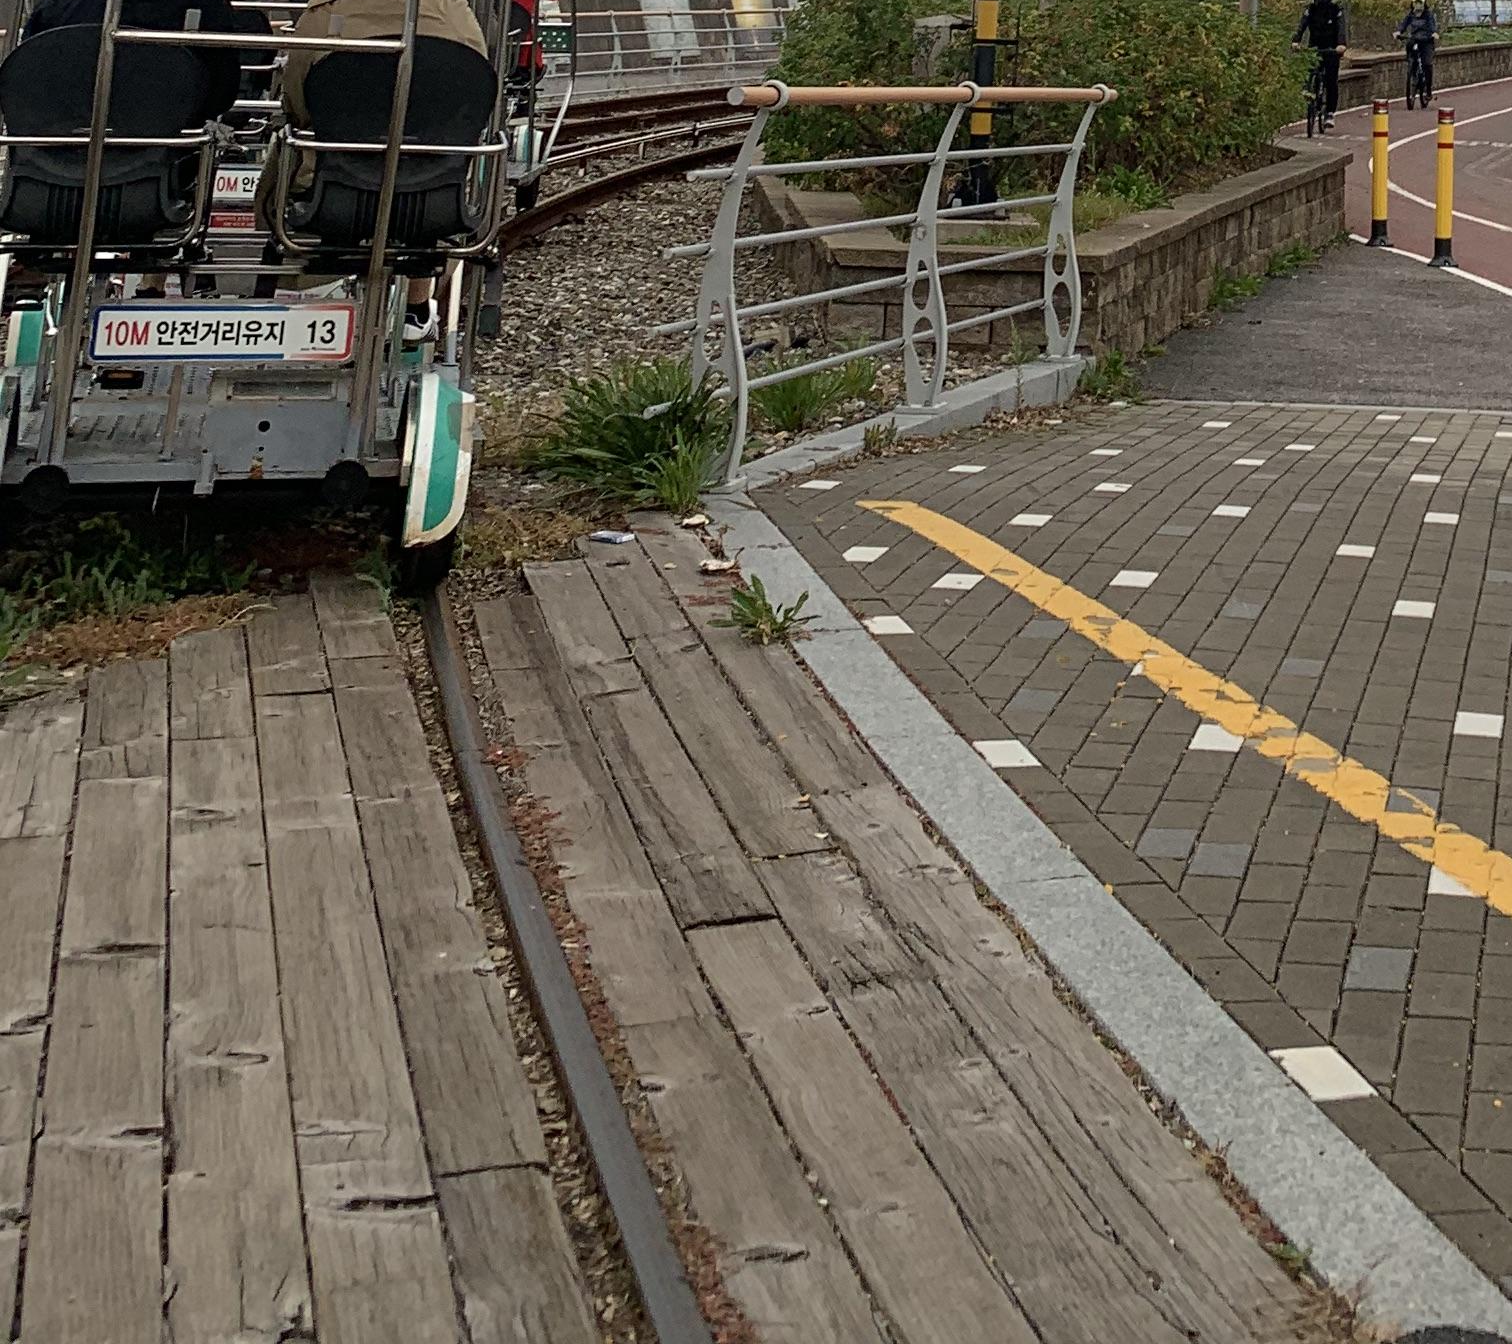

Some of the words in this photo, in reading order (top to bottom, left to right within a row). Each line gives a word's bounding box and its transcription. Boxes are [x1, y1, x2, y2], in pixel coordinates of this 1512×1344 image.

[216, 176, 239, 192] 0M
[104, 320, 150, 346] 10M
[156, 320, 286, 346] 안전거리유지
[306, 319, 336, 345] 13
